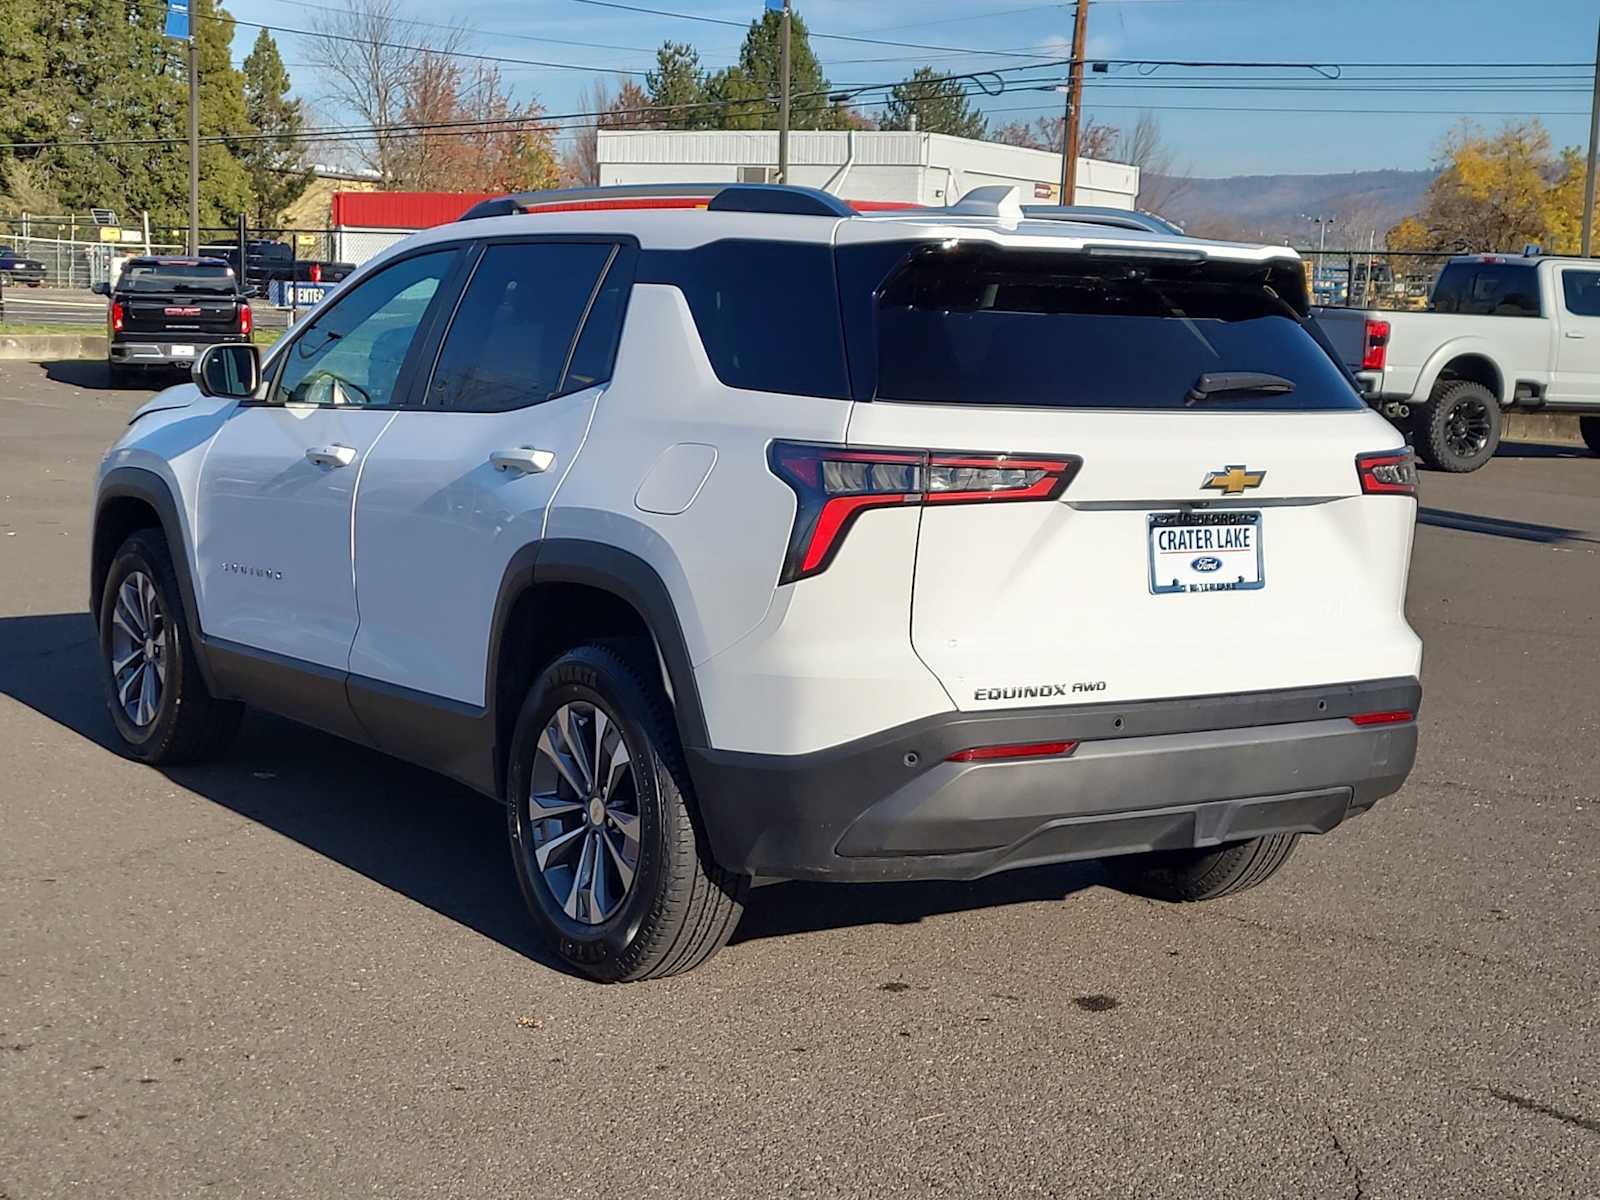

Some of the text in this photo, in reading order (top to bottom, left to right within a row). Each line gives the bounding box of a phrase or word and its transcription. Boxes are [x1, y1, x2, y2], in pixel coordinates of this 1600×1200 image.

[1159, 528, 1250, 550] CRATER LAKE
[1197, 558, 1219, 570] Ford
[974, 681, 1107, 701] EQUINOX AWD
